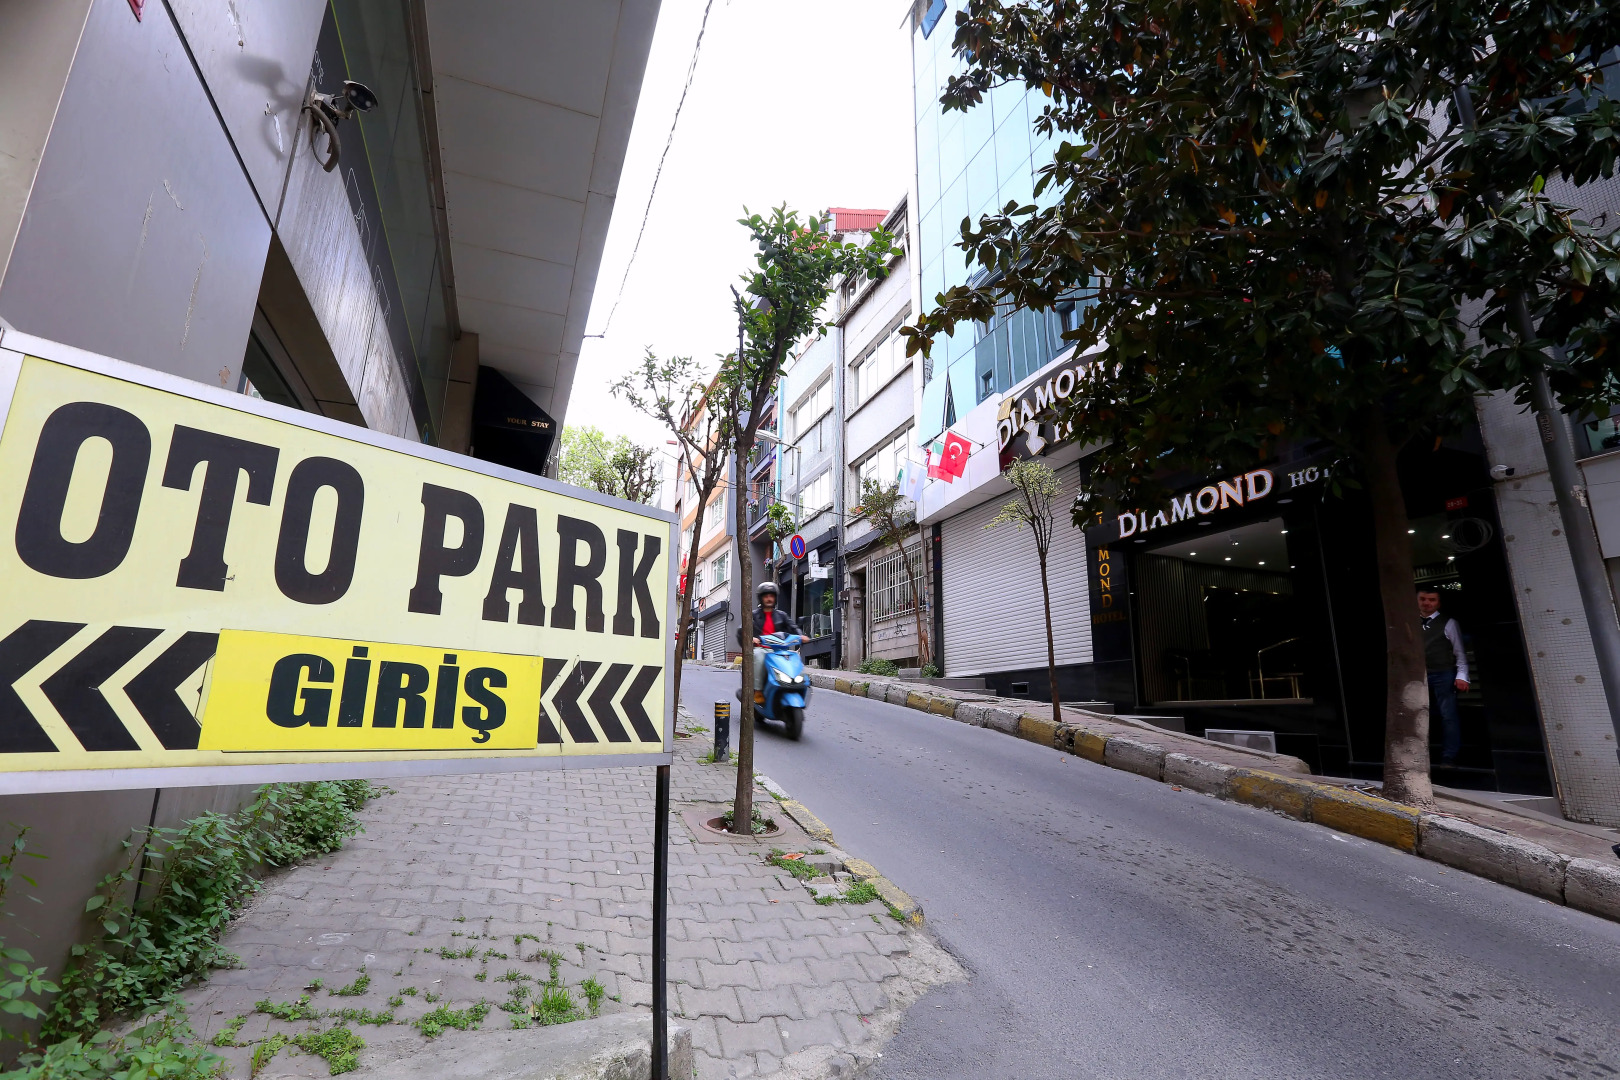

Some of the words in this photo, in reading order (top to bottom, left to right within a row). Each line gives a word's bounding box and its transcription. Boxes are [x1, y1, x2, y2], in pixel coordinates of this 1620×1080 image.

[507, 417, 527, 425] YOUR
[15, 401, 364, 605] OTO
[408, 482, 662, 639] PARK
[1118, 468, 1274, 539] DIAMOND
[265, 645, 508, 743] GİRİŞ
